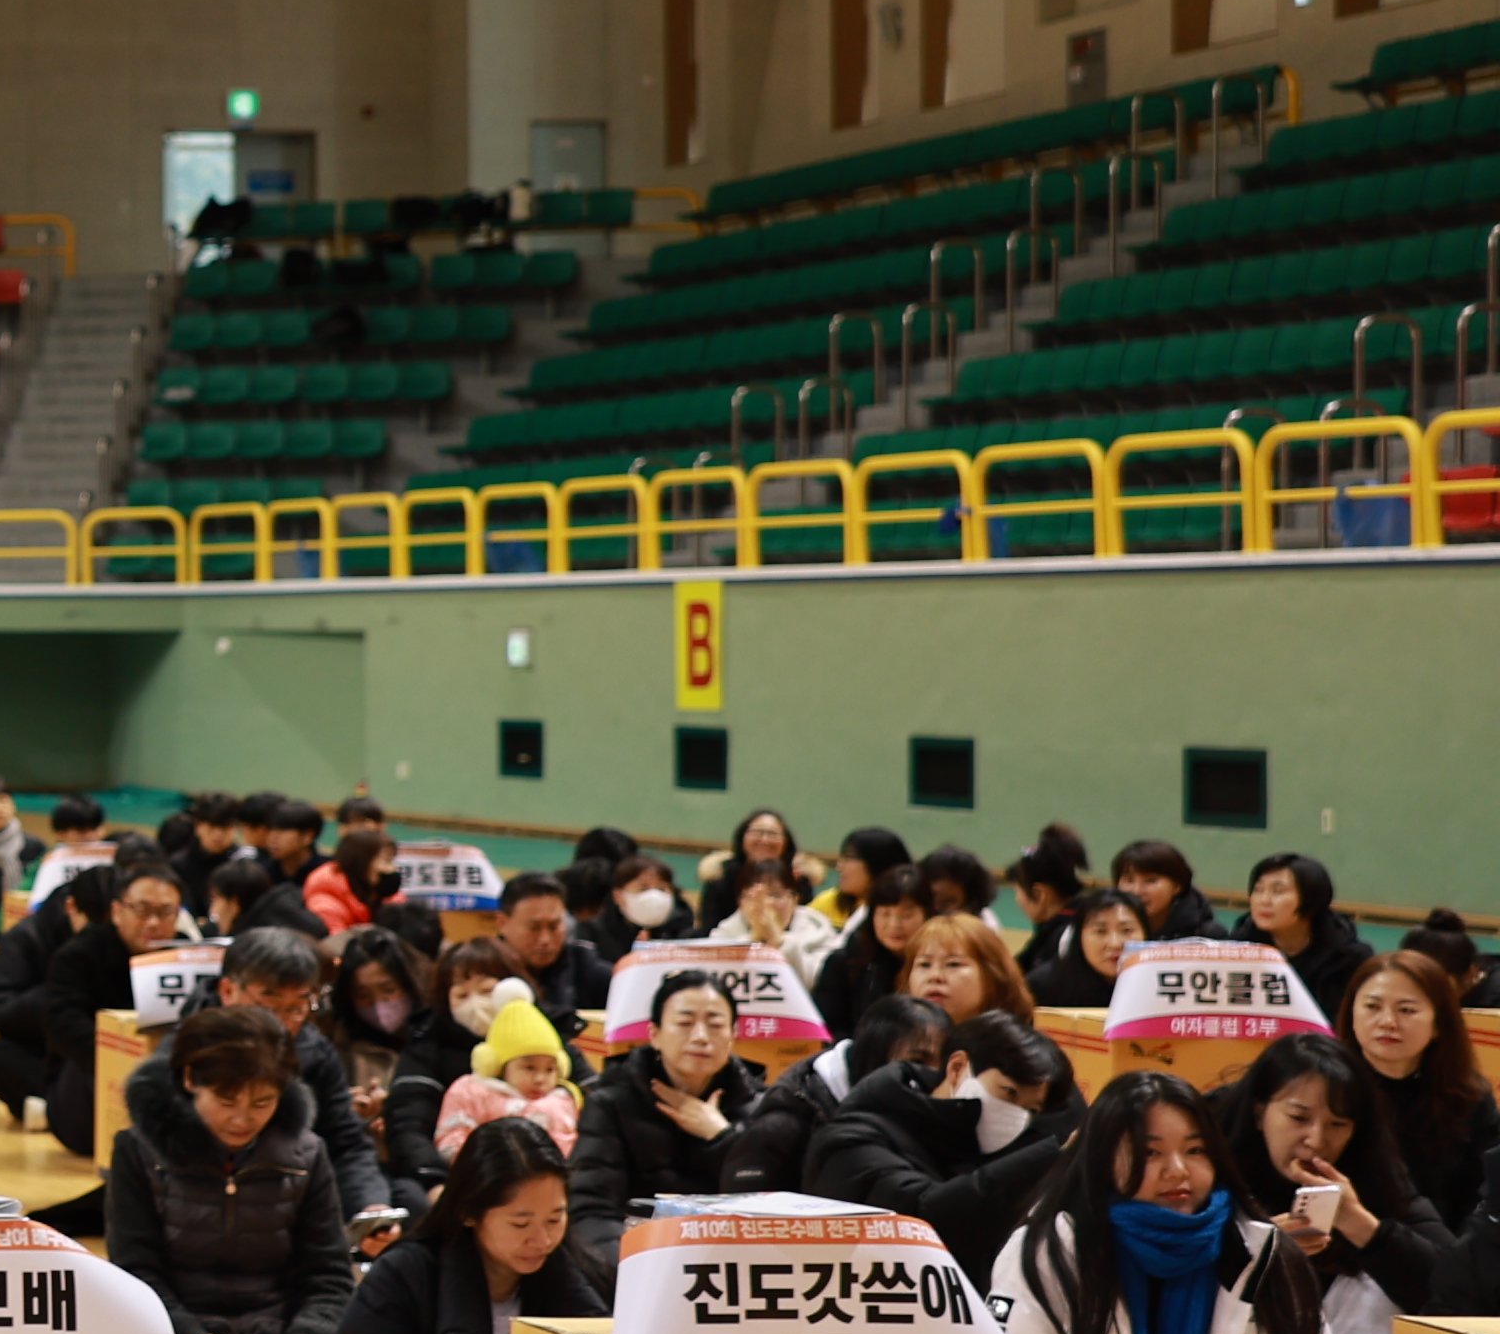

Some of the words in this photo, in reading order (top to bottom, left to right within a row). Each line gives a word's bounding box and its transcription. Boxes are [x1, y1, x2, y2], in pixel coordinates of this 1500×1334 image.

[686, 601, 713, 688] B
[1156, 971, 1291, 1005] 무안클럽
[680, 1220, 736, 1240] 제10회
[739, 1220, 825, 1240] 진도군수배
[828, 1220, 860, 1238] 전국
[864, 1220, 897, 1240] 남여
[683, 1262, 974, 1325] 진도갓쓴애
